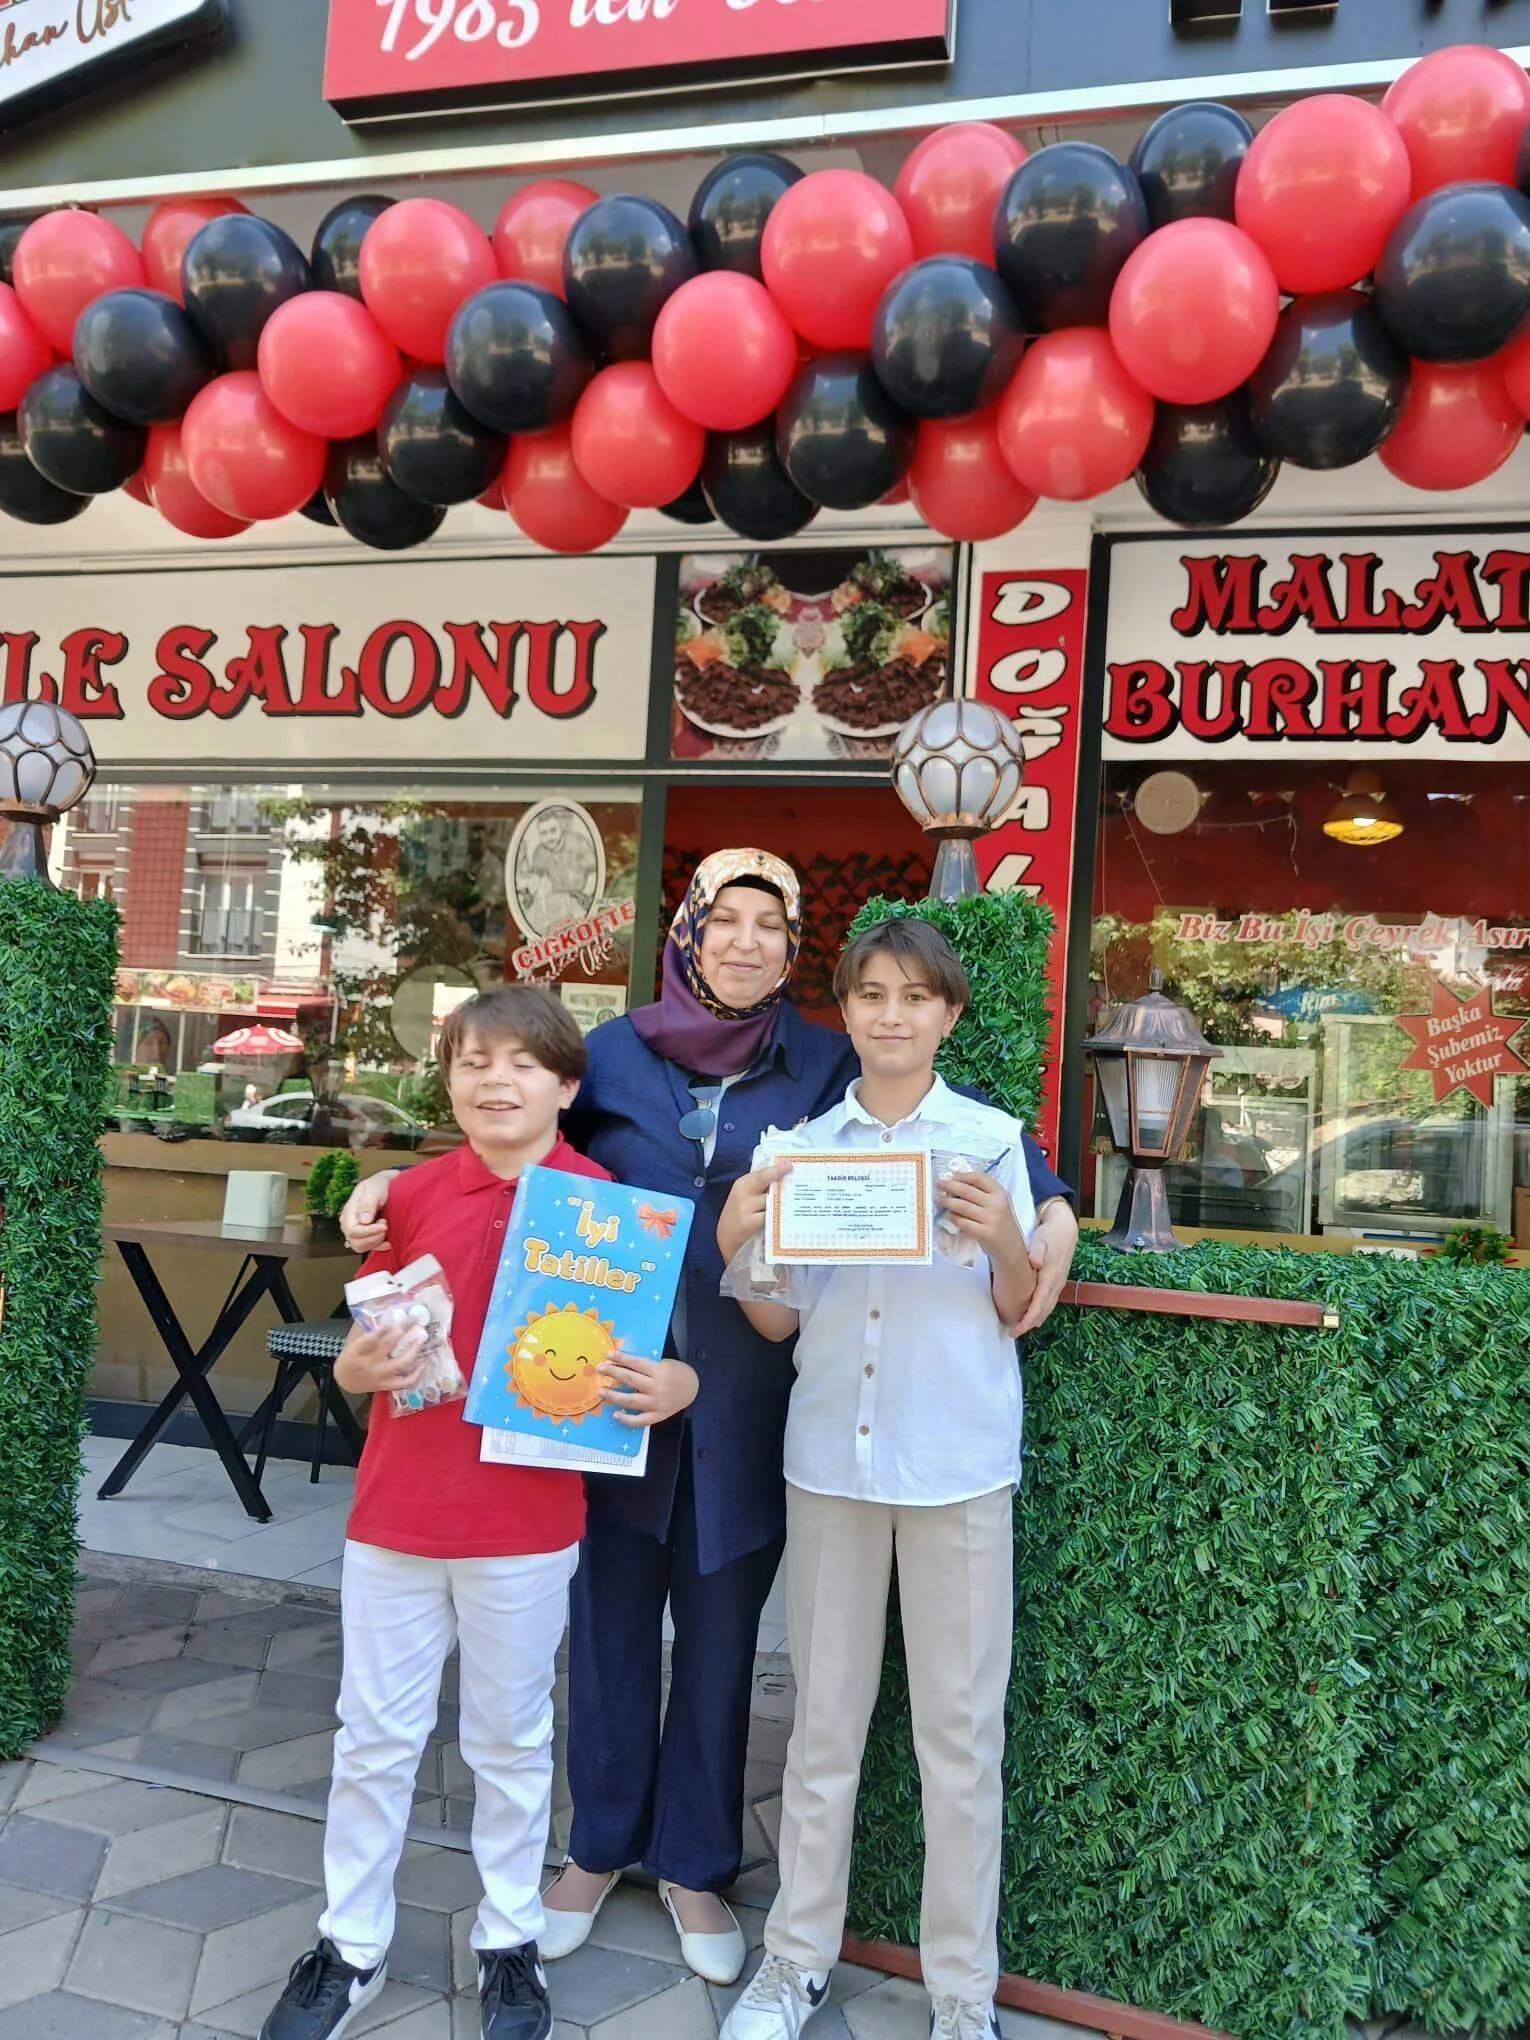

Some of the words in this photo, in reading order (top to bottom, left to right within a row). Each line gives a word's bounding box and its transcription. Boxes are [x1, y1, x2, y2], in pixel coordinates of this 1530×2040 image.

[1171, 550, 1530, 637] MALAT
[0, 627, 129, 720] LE
[147, 619, 607, 719] SALONU
[1103, 658, 1530, 743] BURHAN
[1175, 912, 1232, 943] Biz
[1234, 914, 1284, 943] Bu
[1290, 908, 1335, 949] İşi
[1344, 915, 1454, 951] Çeyrek
[1426, 1006, 1482, 1037] Başka
[1427, 1024, 1504, 1069] Şubemiz
[1443, 1053, 1502, 1084] Yoktur
